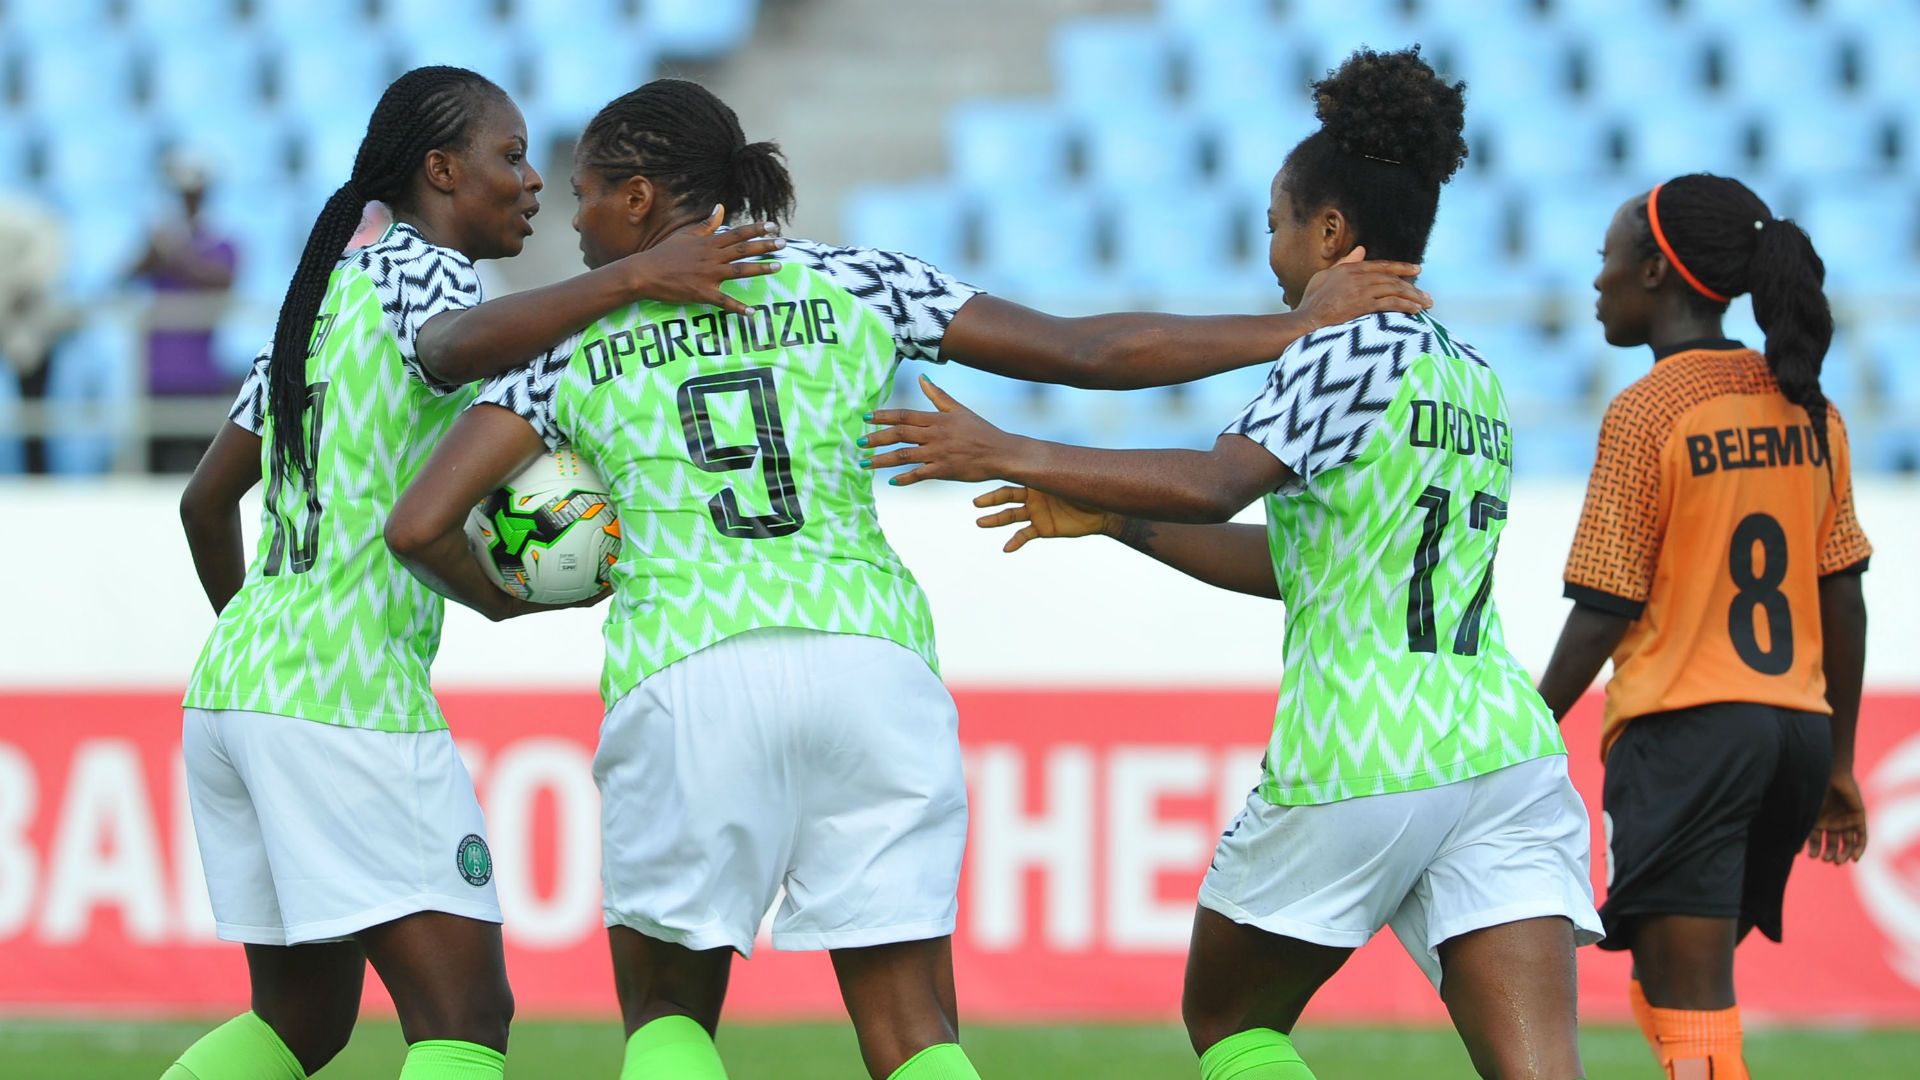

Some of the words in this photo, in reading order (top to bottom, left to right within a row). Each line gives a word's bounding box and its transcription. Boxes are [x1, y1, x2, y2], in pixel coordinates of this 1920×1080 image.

[677, 367, 805, 539] 9
[1410, 399, 1513, 471] ORDEG
[1407, 485, 1508, 656] 17
[1728, 513, 1794, 676] 8
